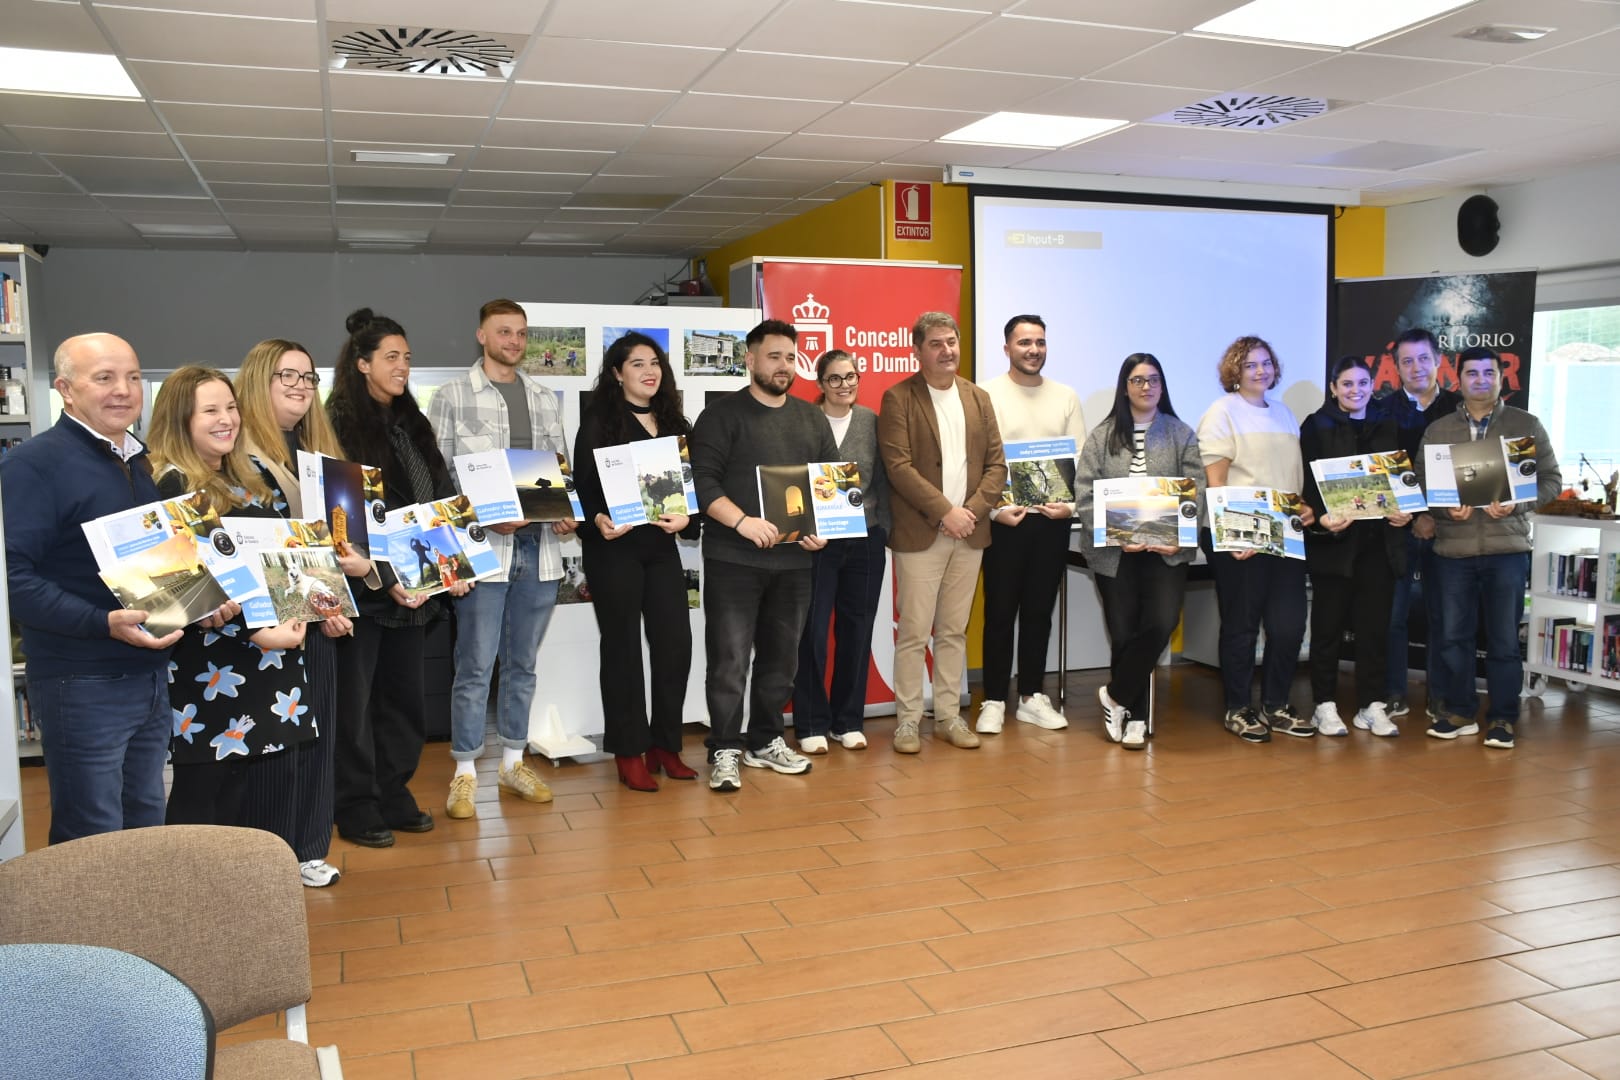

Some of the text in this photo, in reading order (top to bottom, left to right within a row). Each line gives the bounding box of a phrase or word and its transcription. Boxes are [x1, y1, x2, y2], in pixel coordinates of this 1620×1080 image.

[896, 226, 930, 237] EXTINTOR
[1027, 233, 1065, 246] Input-B
[1438, 332, 1515, 348] RITORIO
[852, 352, 920, 373] e Dumb
